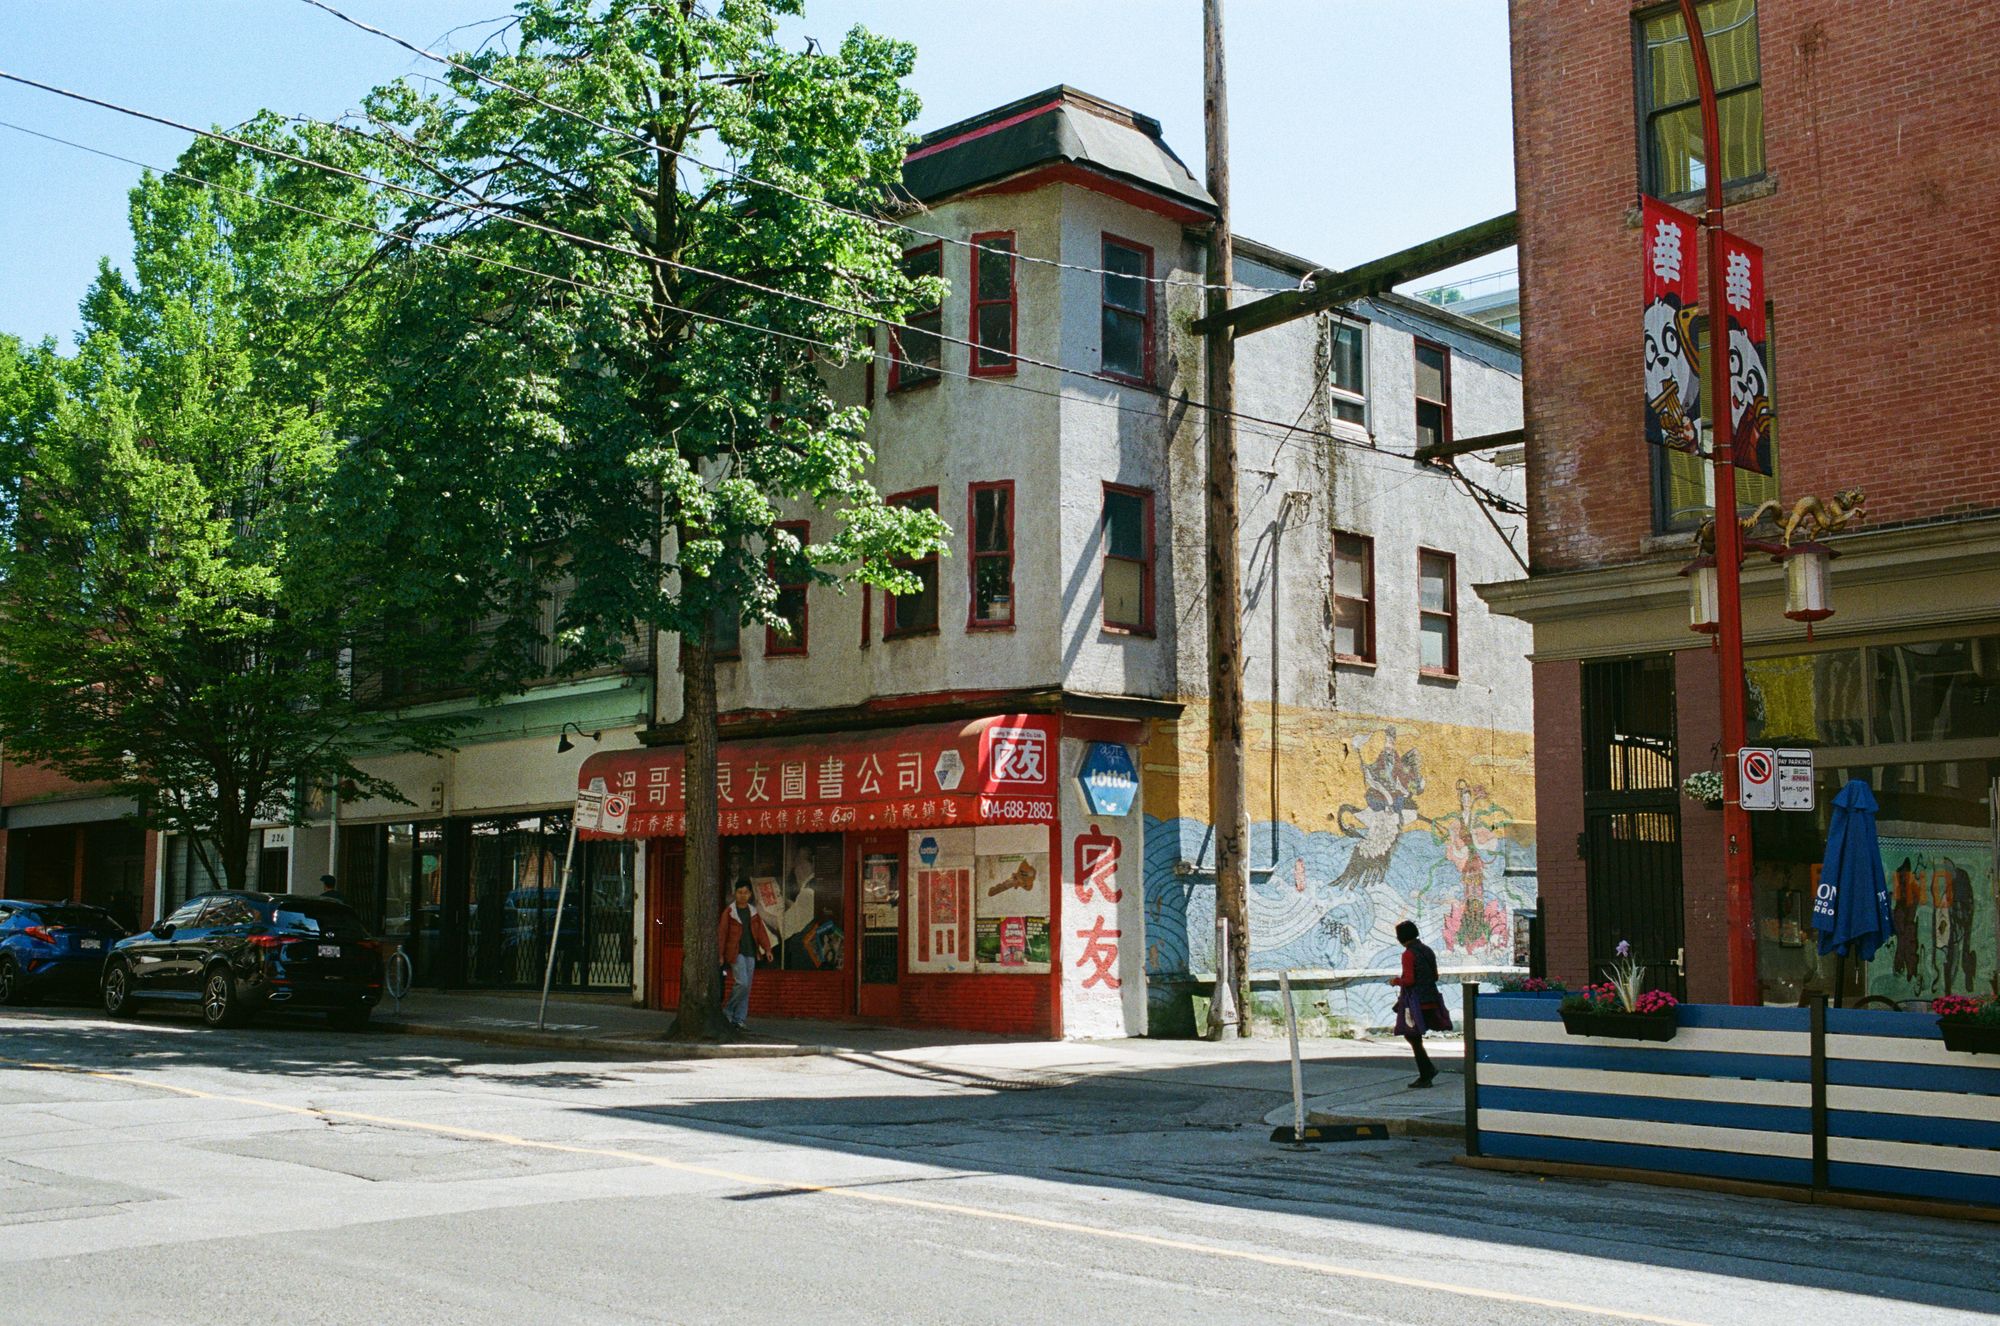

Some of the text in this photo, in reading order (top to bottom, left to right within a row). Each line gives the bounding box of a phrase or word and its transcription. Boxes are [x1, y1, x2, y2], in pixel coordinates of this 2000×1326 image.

[616, 751, 923, 807] 溫哥良友圖書公司
[994, 739, 1043, 780] 良友
[980, 799, 1054, 819] 604-688-2882
[1074, 824, 1123, 990] 良友
